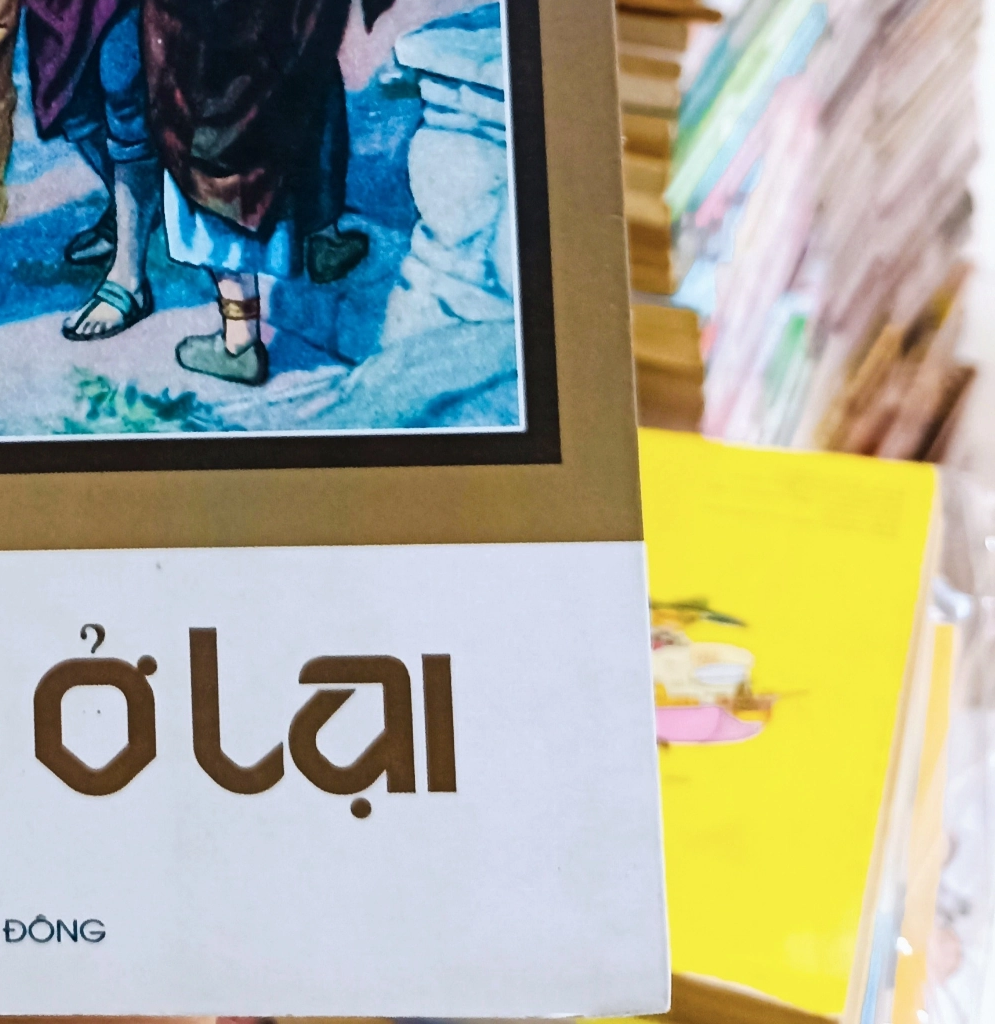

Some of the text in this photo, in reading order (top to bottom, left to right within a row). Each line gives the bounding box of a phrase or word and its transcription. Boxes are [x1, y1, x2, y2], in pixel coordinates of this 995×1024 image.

[32, 622, 159, 797] ở
[187, 626, 458, 820] lại
[2, 913, 107, 944] ĐÔNG
